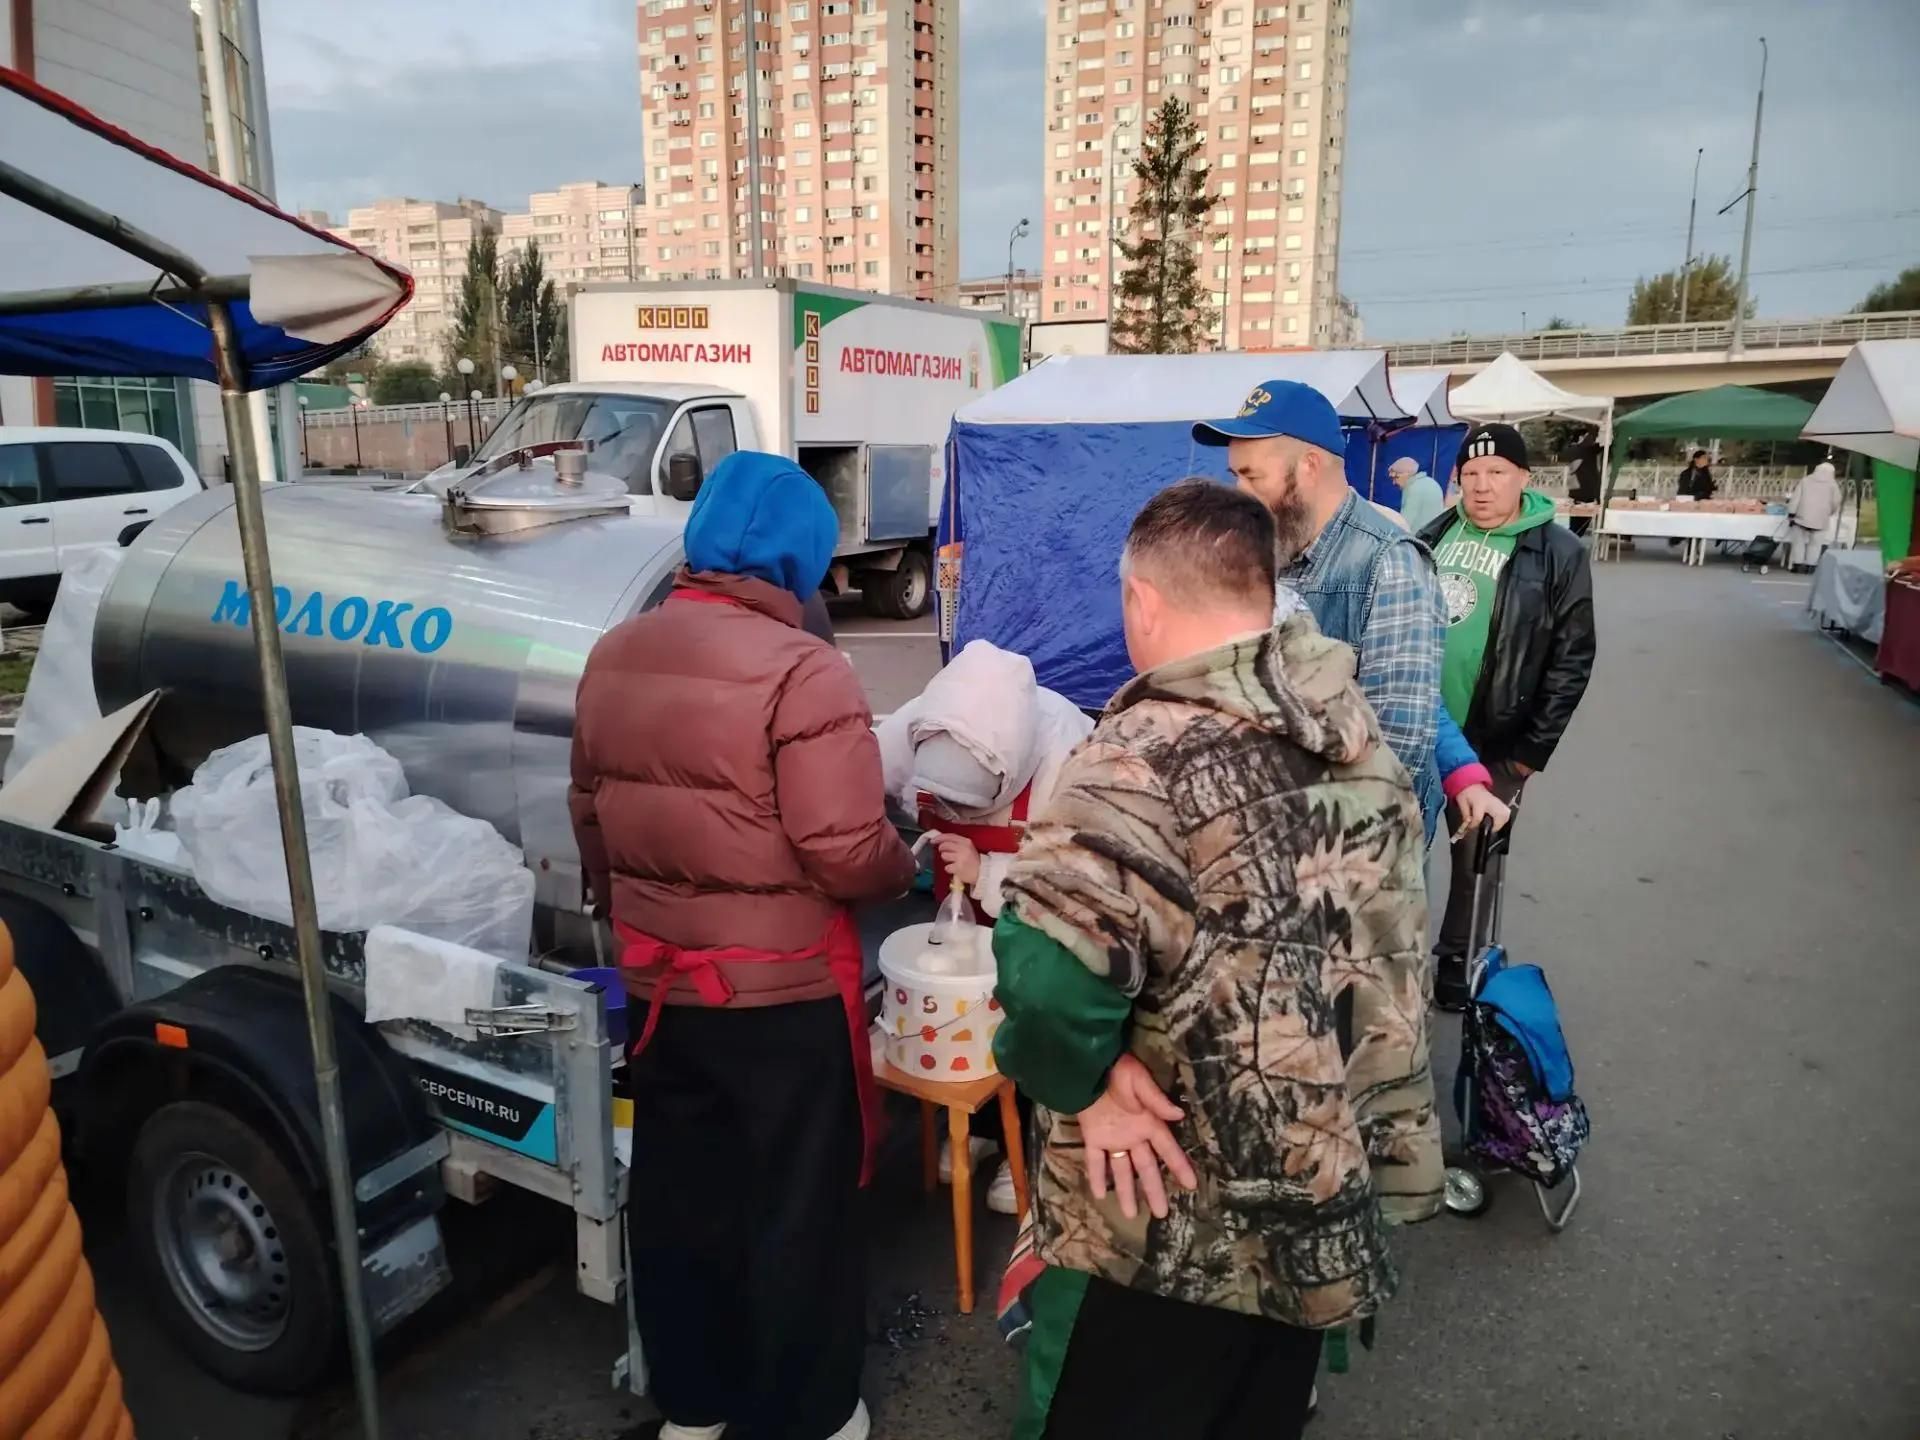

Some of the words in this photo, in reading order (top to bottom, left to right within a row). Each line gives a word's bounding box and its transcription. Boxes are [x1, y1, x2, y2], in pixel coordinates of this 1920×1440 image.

[639, 308, 709, 328] КООП
[602, 343, 751, 363] АВТОМАГАЗИН
[807, 314, 819, 413] КООП
[840, 346, 962, 380] АВТОМАГАЗИН
